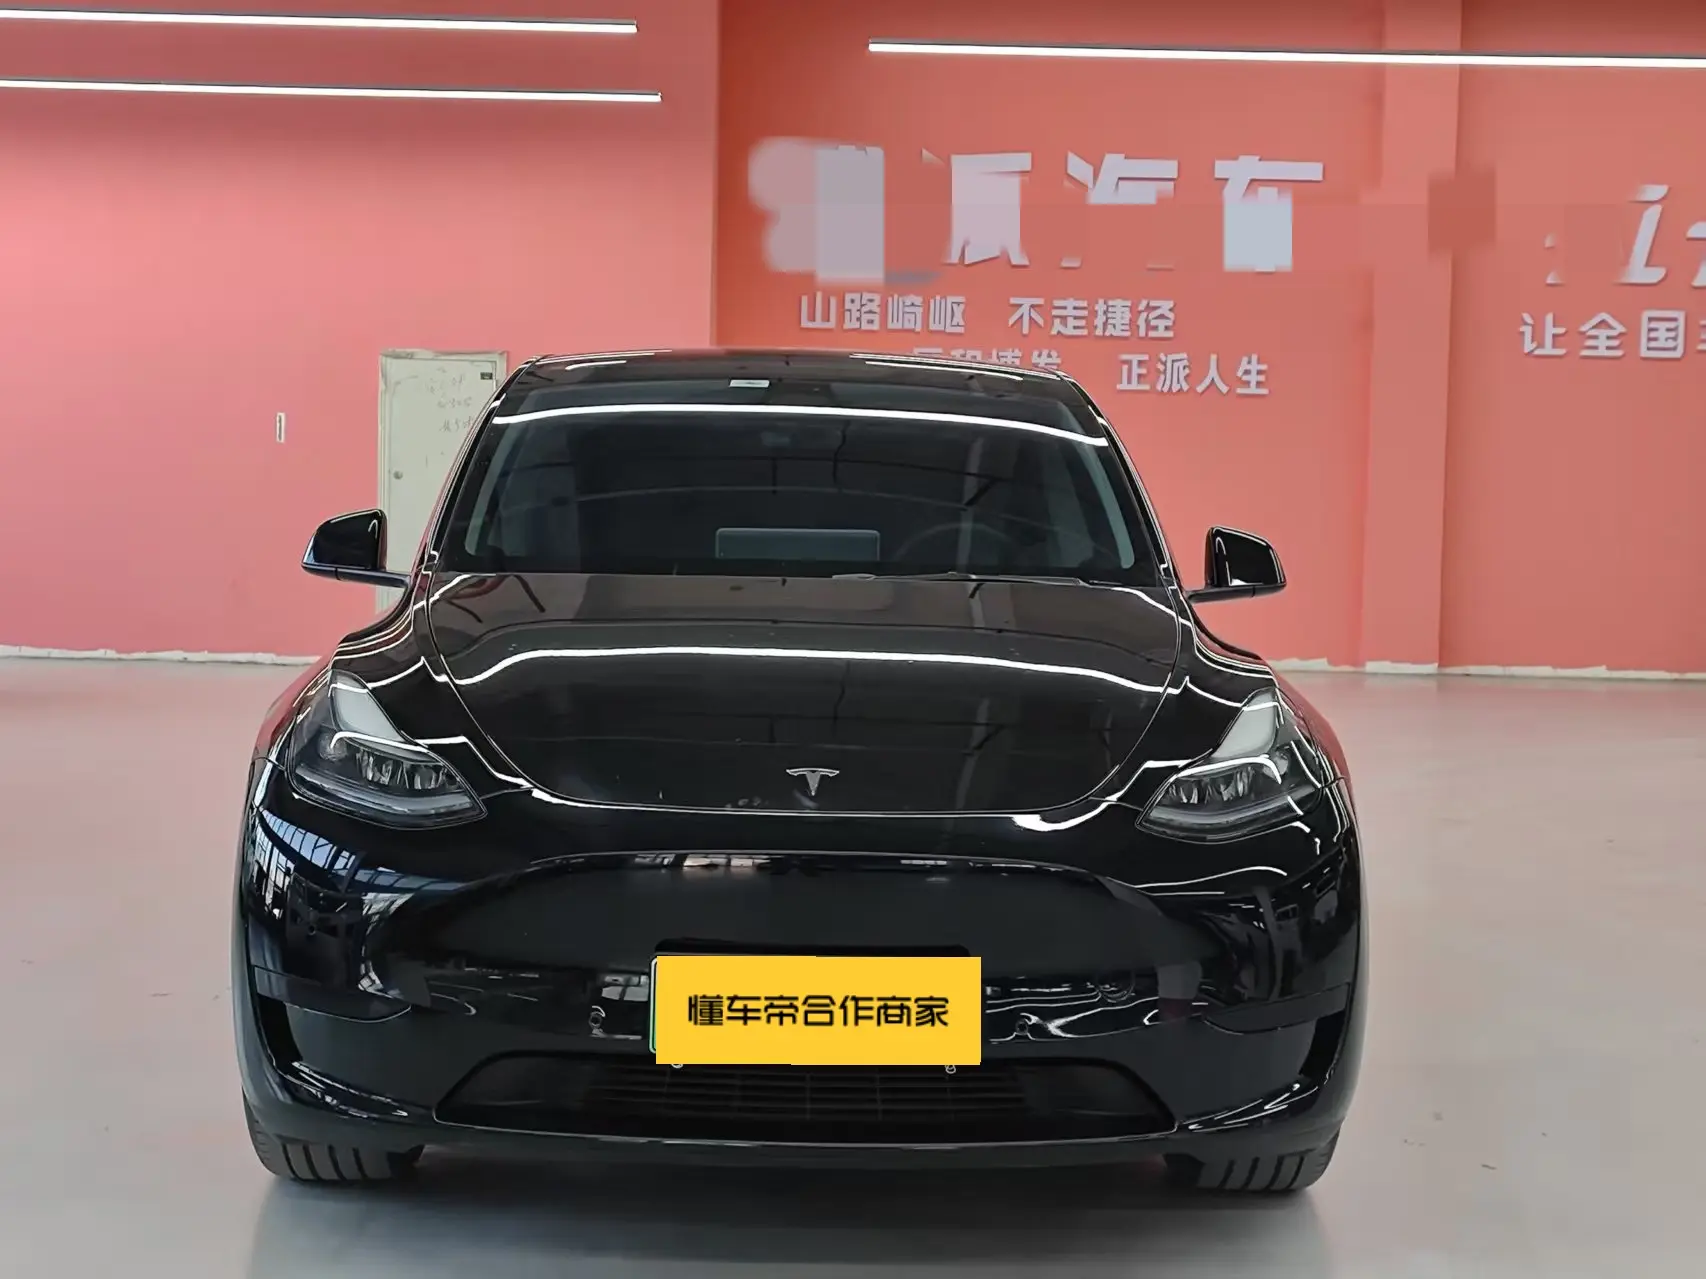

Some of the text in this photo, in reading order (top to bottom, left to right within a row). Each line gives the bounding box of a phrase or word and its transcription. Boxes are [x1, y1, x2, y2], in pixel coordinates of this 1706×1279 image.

[800, 291, 1175, 338] 山路崎岖 不走捷径
[1518, 309, 1706, 359] 让全国
[1116, 352, 1270, 395] 正派人生
